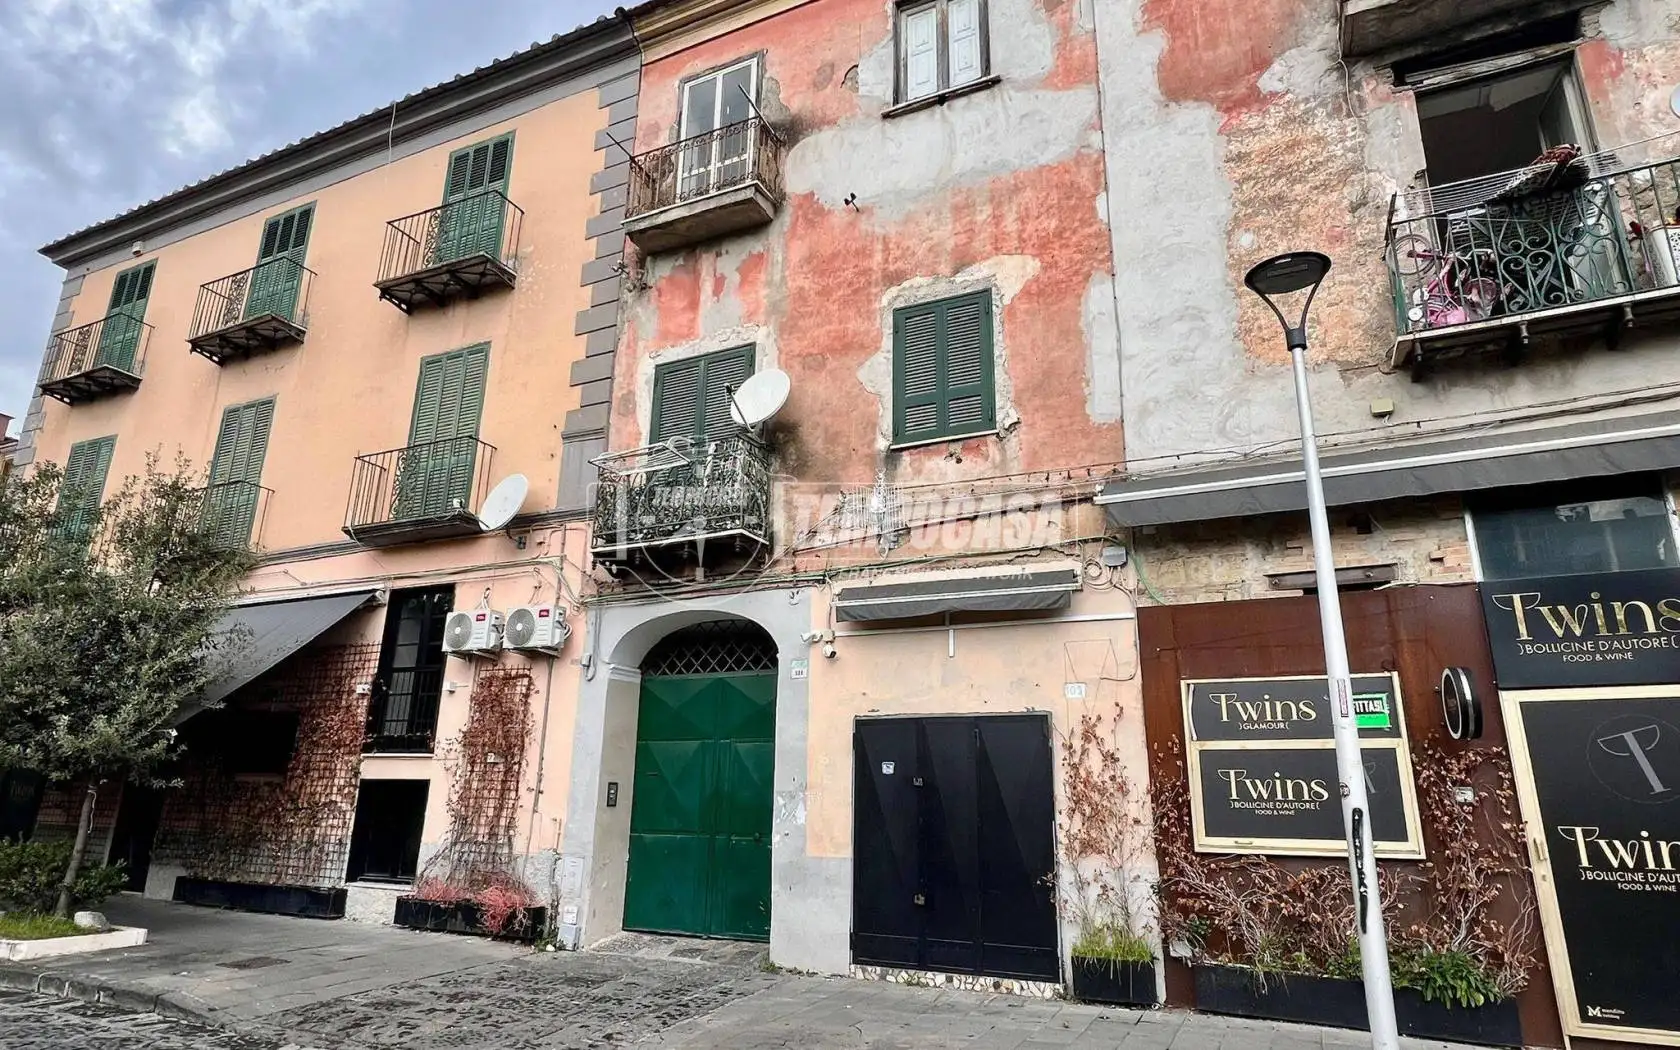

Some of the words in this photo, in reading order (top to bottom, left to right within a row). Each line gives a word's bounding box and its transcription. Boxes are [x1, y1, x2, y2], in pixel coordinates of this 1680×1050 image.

[1562, 653, 1593, 663] FOOD
[1595, 653, 1603, 662] &
[1605, 652, 1634, 661] WINE
[1209, 693, 1317, 722] Twins
[1217, 769, 1329, 801] Twins
[1648, 872, 1680, 883] D'AUT
[1617, 882, 1643, 891] FOOD
[1653, 884, 1677, 892] WINE
